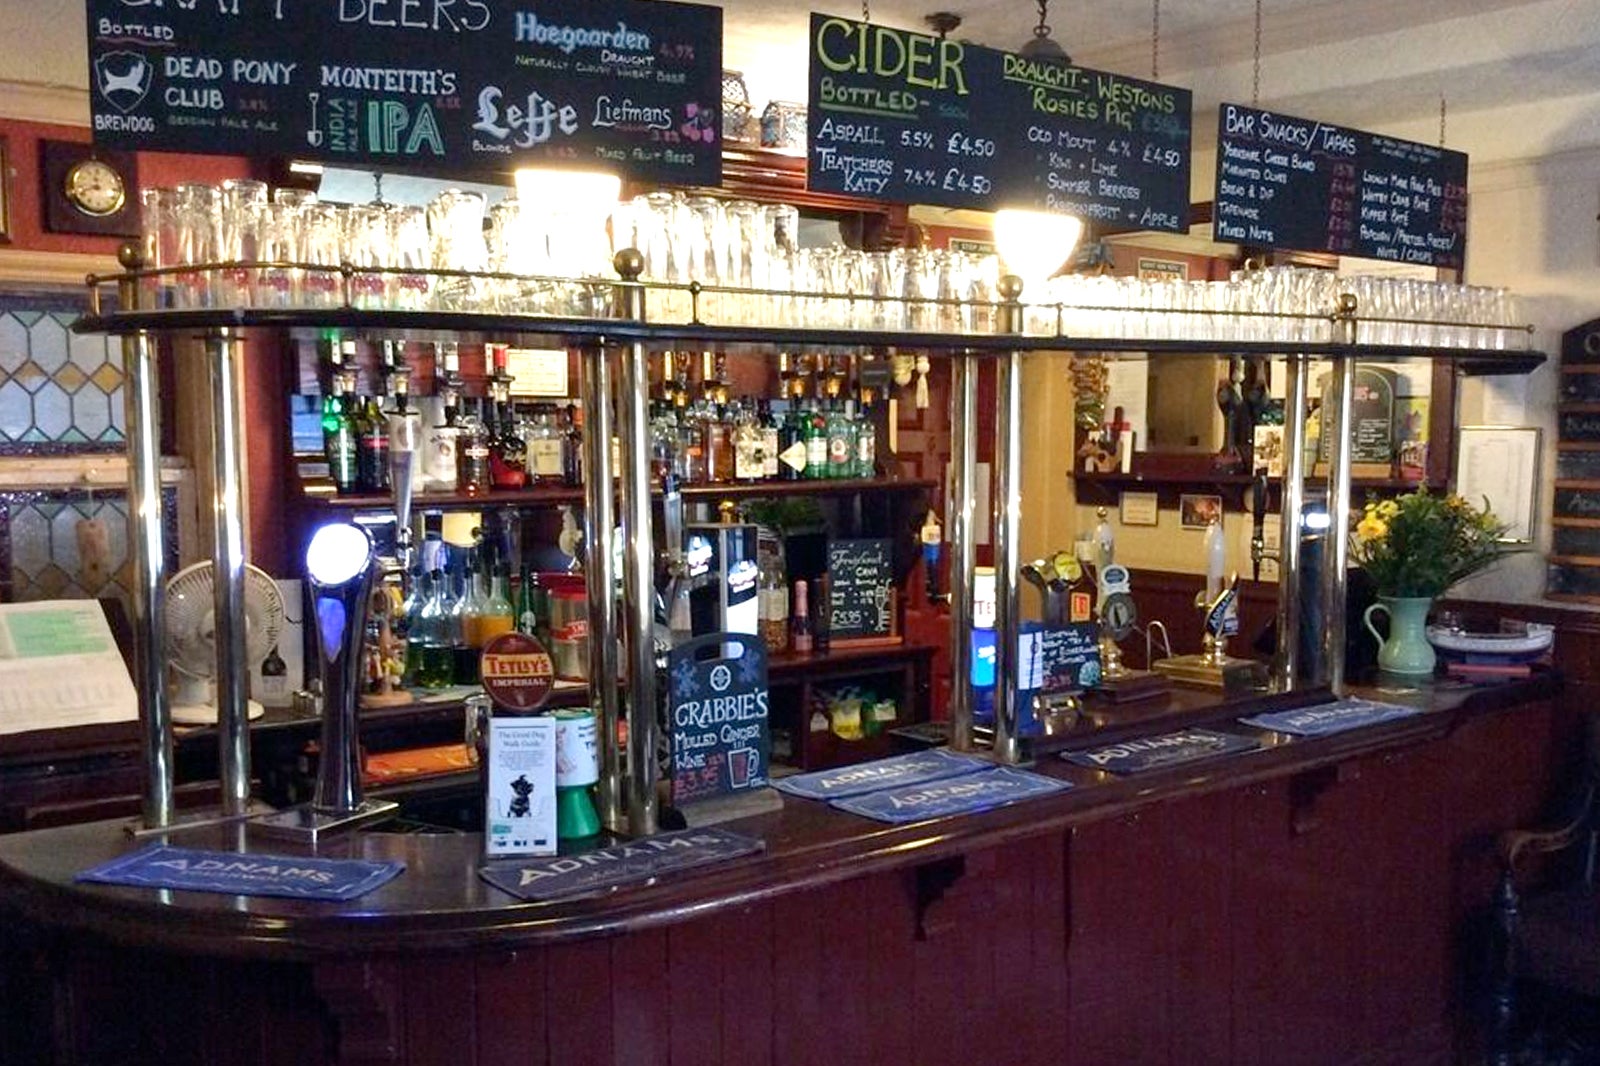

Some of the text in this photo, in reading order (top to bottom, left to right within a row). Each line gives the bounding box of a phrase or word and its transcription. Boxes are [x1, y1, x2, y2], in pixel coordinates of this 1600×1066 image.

[99, 18, 174, 40] BOTTLED
[515, 11, 651, 53] Hoegaarden
[165, 56, 297, 85] DEAD PONY
[601, 49, 655, 66] DRAUGHT
[816, 18, 970, 95] CIDER
[321, 65, 457, 95] MONTEITH'S
[1097, 75, 1176, 114] WESTONS
[164, 87, 225, 110] CLUB
[591, 95, 672, 130] Liefmans
[95, 114, 155, 132] BREWDOG
[328, 98, 346, 151] INDIA
[367, 100, 446, 155] IPA
[471, 85, 578, 148] Leffe
[1226, 106, 1255, 134] BAR
[816, 118, 885, 144] ASPALL
[947, 132, 996, 157] £4.50
[815, 147, 894, 176] THATCHERS
[843, 169, 889, 194] KATY
[1140, 207, 1179, 228] APPLE
[855, 566, 879, 578] CAVA
[674, 687, 769, 729] CRABBIE'S
[674, 724, 761, 752] MULLED GINGER
[675, 751, 707, 770] WINE
[150, 859, 335, 884] ADNAMS
